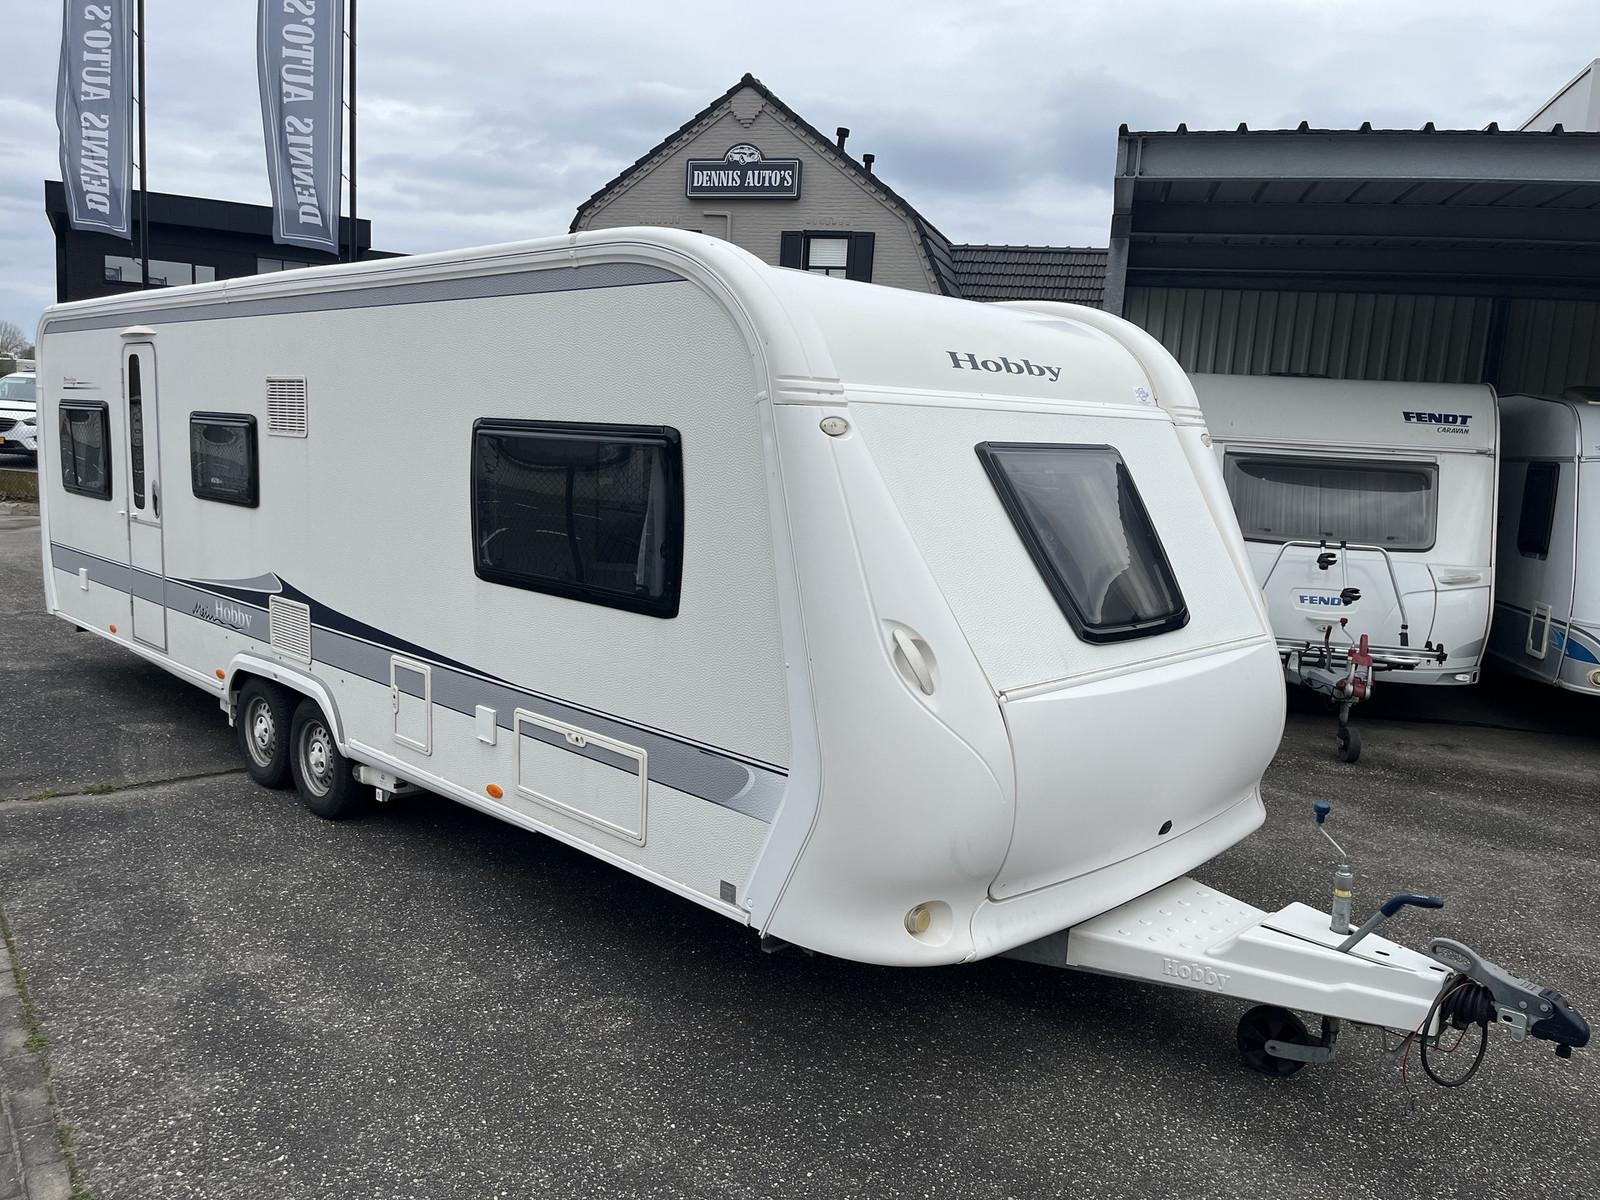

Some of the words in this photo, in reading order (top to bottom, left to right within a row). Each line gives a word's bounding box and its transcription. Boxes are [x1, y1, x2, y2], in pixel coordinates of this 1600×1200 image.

[693, 170, 741, 187] DENNIS
[745, 170, 793, 187] AUTO'S
[946, 350, 1062, 382] Hobby
[1402, 411, 1473, 425] FENDT
[1437, 426, 1470, 435] CARAVAN
[1299, 595, 1342, 606] FEND
[215, 600, 252, 629] Hobby
[1162, 958, 1231, 992] Hobby
